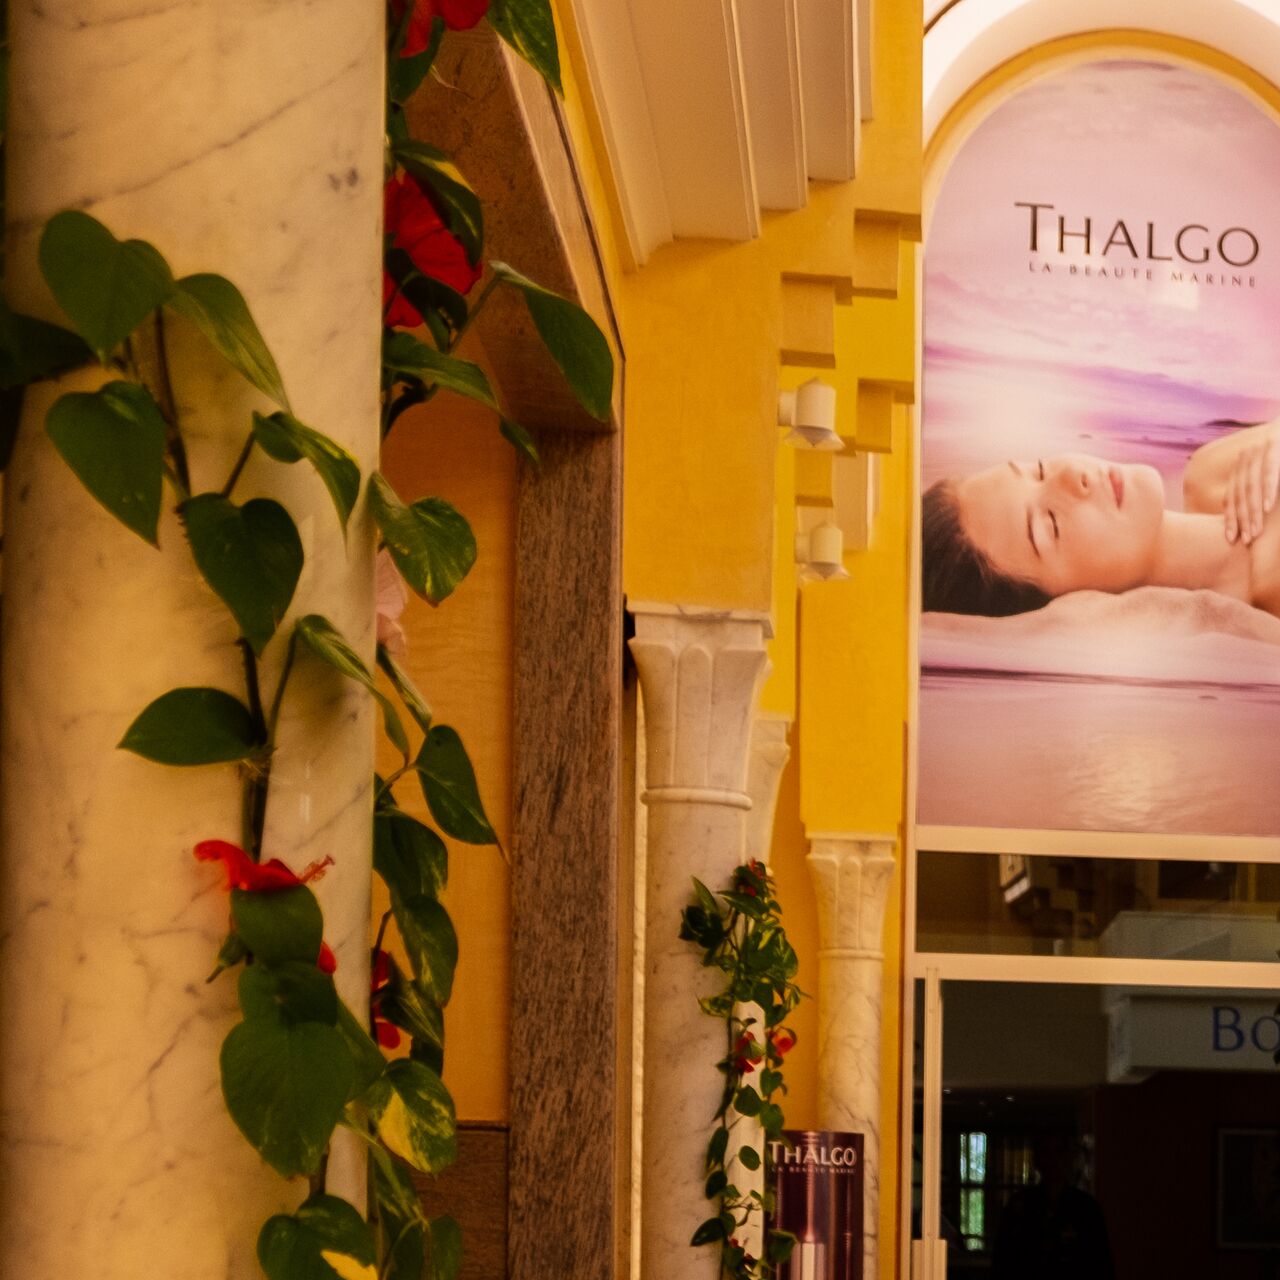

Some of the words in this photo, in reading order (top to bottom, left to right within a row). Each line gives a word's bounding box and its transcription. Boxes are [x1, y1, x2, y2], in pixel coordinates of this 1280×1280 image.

[1014, 201, 1260, 267] THALGO
[1028, 261, 1052, 274] LA
[1171, 272, 1257, 288] MARINE
[768, 1141, 857, 1167] THALGO
